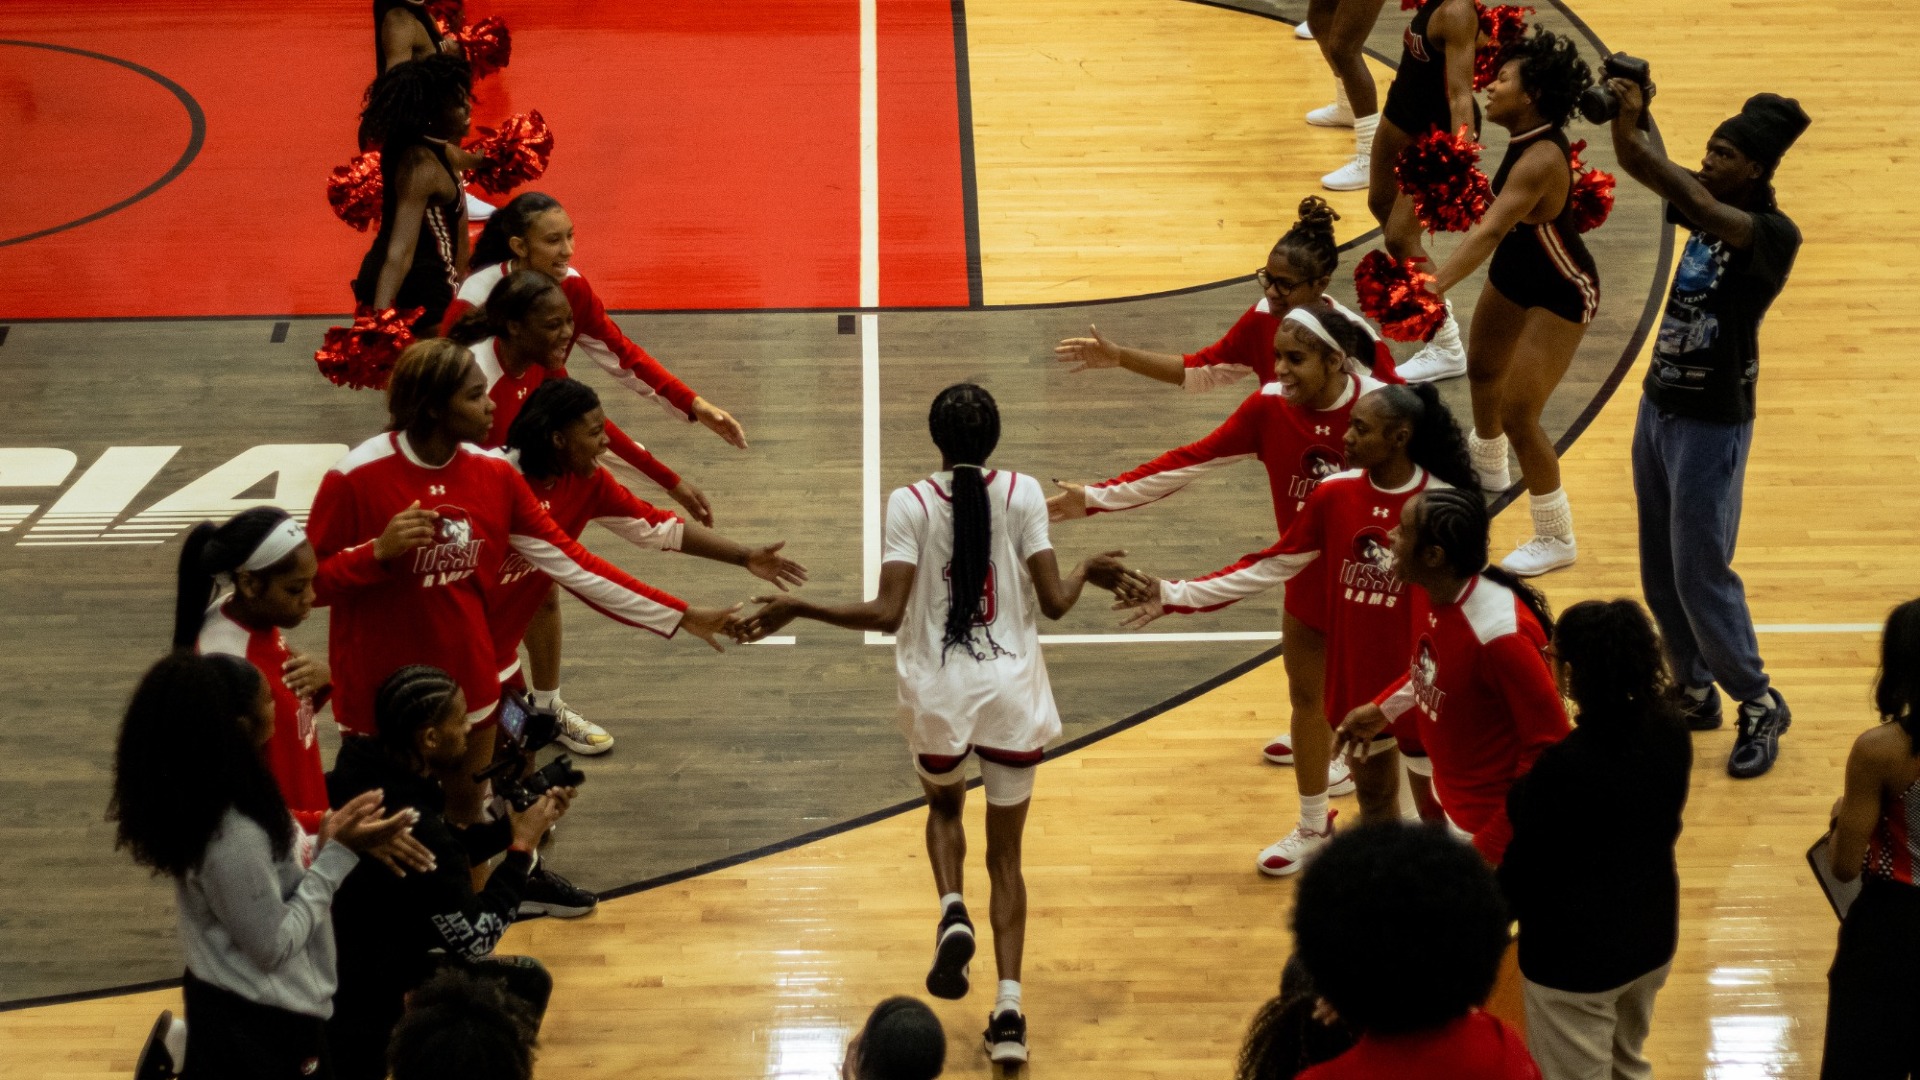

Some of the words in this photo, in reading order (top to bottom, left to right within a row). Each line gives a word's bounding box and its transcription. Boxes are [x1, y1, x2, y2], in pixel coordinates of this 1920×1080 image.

[1683, 292, 1708, 303] TEAM
[1344, 587, 1398, 608] RAMS
[444, 910, 475, 941] ART
